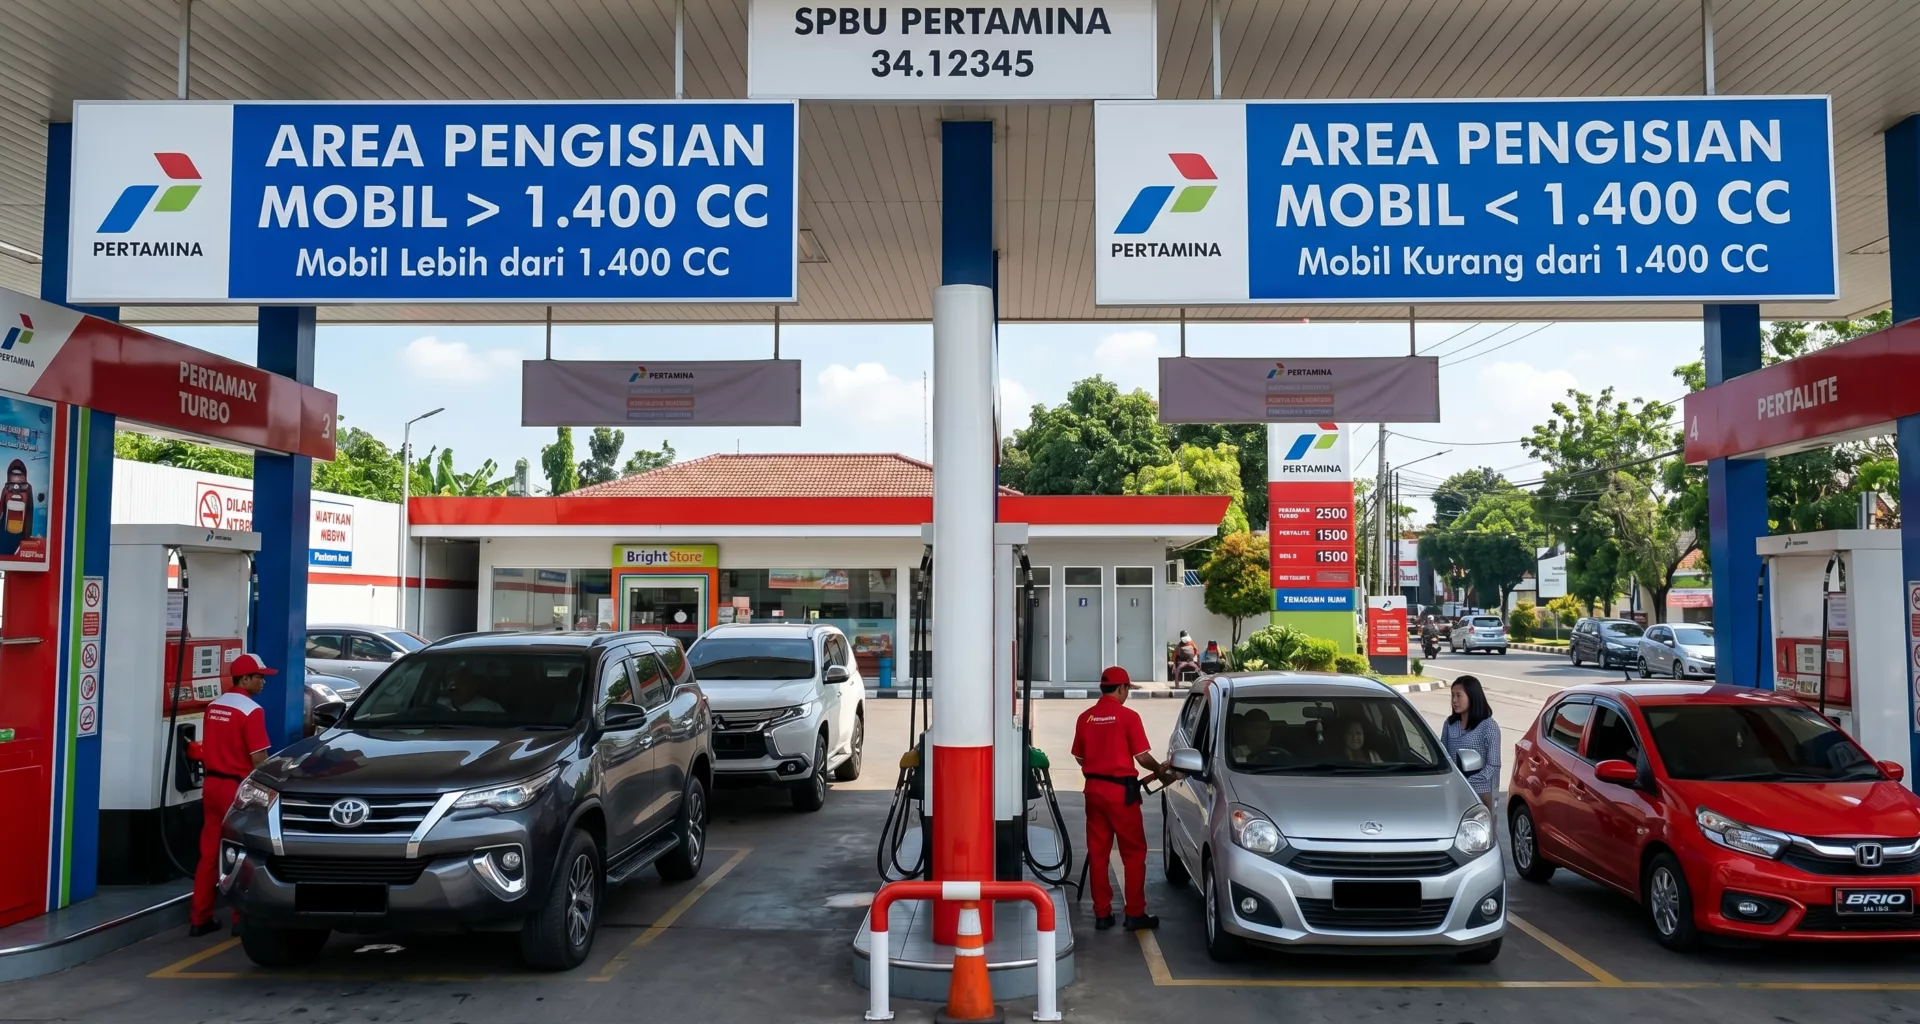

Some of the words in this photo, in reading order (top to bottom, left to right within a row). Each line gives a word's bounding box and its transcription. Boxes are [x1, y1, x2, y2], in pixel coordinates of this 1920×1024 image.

[794, 7, 887, 36] SPBU
[901, 7, 1112, 35] PERTAMINA
[871, 49, 1035, 78] 34.12345
[265, 124, 424, 167] AREA
[445, 123, 765, 167] PENGISIAN
[1281, 121, 1438, 166] AREA
[1458, 119, 1782, 165] PENGISIAN
[258, 184, 448, 229] MOBIL
[467, 193, 500, 227] >
[525, 184, 677, 229] 1.400
[696, 183, 769, 228] CC
[1275, 182, 1465, 227] MOBIL
[1485, 190, 1519, 225] <
[1544, 180, 1698, 226] 1.400
[1717, 179, 1791, 225] CC
[93, 241, 204, 258] PERTAMINA
[295, 246, 388, 277] Mobil
[401, 246, 487, 277] Lebih
[500, 246, 564, 277] dari
[579, 247, 671, 277] 1.400
[682, 247, 730, 276] CC
[1111, 242, 1222, 258] PERTAMINA
[1298, 245, 1390, 276] Mobil
[1403, 246, 1523, 282] Kurang
[1536, 243, 1601, 275] dari
[1616, 244, 1709, 274] 1.400
[1721, 243, 1769, 273] CC
[179, 361, 258, 402] PERTAMAX
[649, 371, 694, 380] PERTAMINA
[1287, 368, 1333, 377] PERTAMINA
[179, 391, 231, 424] TURBO
[1757, 375, 1838, 421] PERTALITE
[321, 413, 331, 439] 3
[1689, 415, 1699, 442] 4
[1283, 464, 1342, 473] PERTAMINA
[1316, 508, 1347, 519] 2500
[1317, 529, 1348, 541] 1500
[1318, 551, 1348, 562] 1500
[1846, 894, 1906, 905] BRIO
